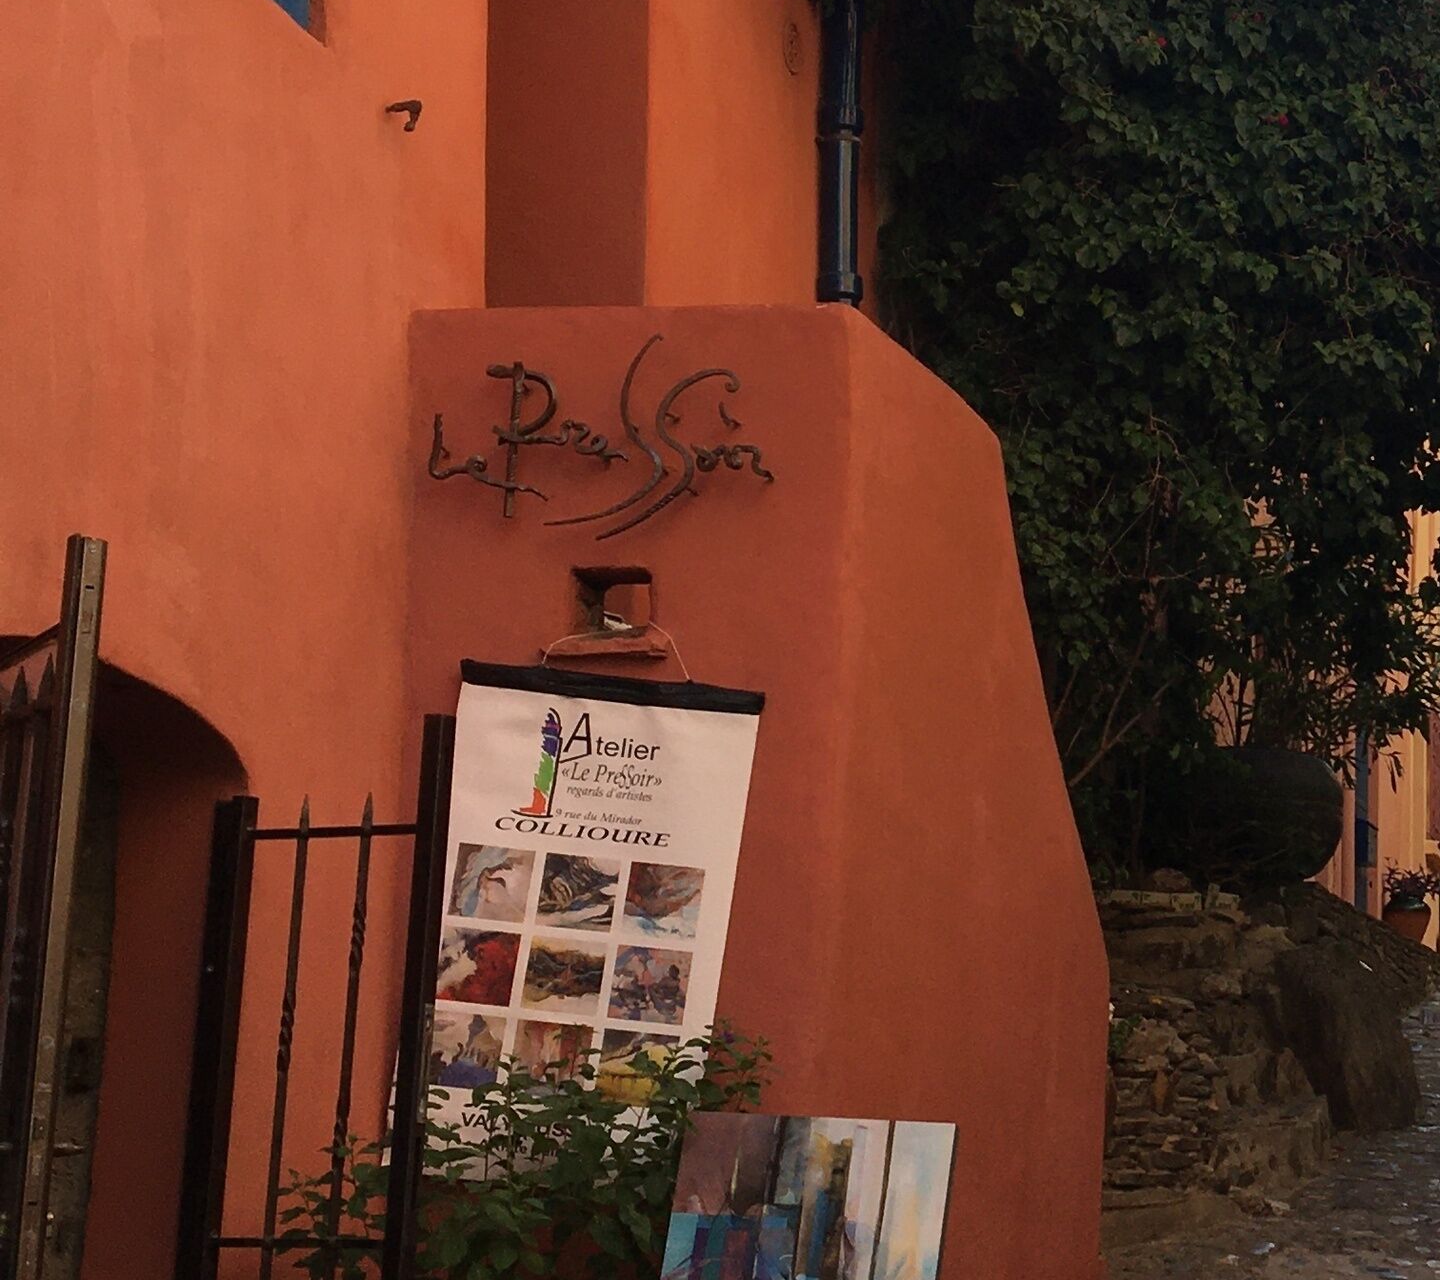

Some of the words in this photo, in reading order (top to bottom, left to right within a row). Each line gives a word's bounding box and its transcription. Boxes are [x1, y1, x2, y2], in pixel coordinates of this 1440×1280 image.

[427, 412, 549, 502] Le
[559, 712, 660, 763] Atelier
[566, 785, 604, 799] regards
[606, 787, 653, 802] d'artistes
[495, 816, 671, 848] COLLIOURE
[555, 808, 563, 818] 9
[565, 810, 582, 819] rue
[584, 810, 597, 821] du
[601, 812, 643, 826] Mirador
